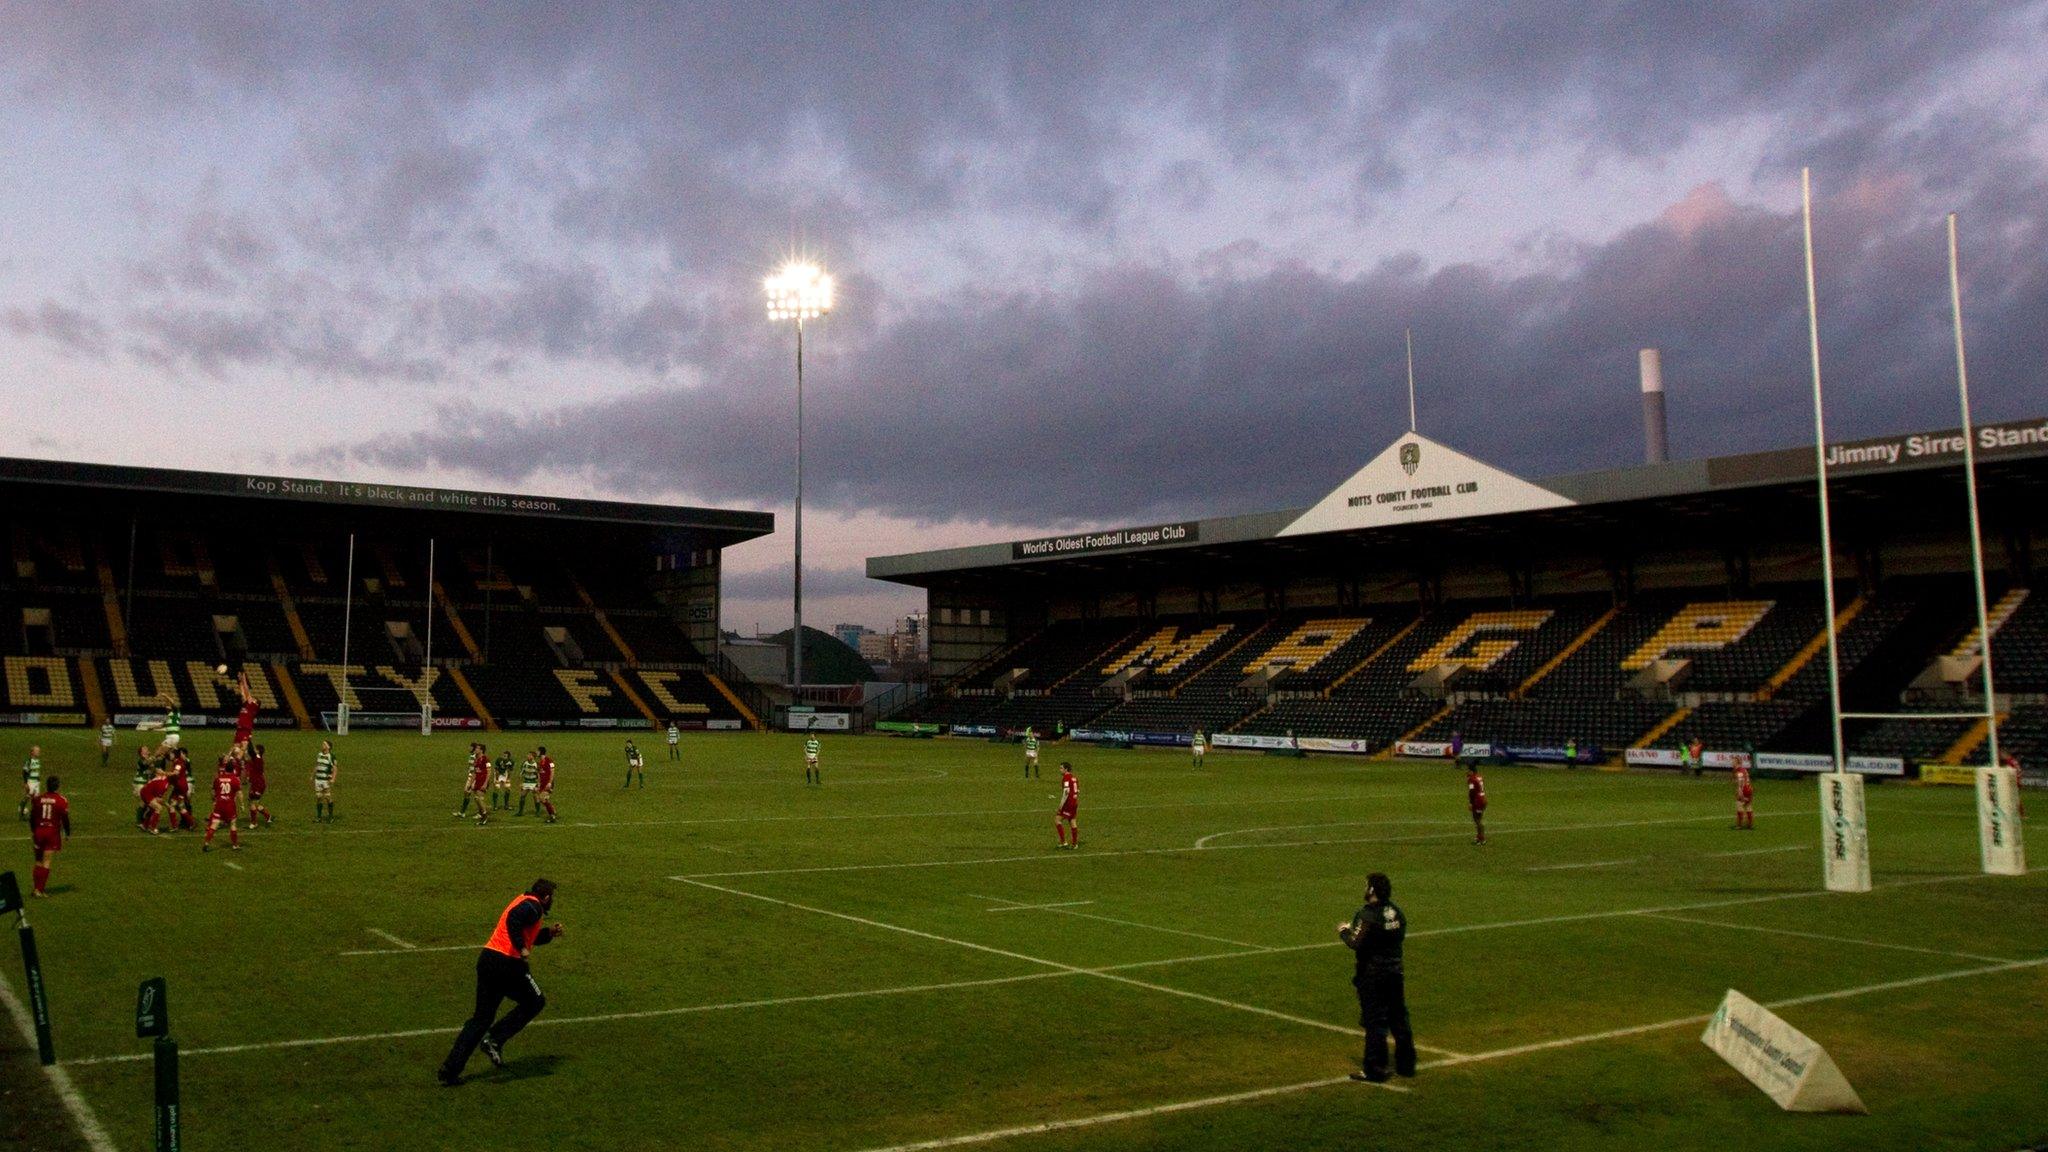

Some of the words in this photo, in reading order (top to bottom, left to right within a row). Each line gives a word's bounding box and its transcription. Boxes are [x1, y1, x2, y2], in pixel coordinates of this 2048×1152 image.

[1826, 443, 1900, 466] Jimmy
[1906, 434, 1968, 456] Sirre
[246, 478, 275, 494] Kop
[281, 480, 328, 496] Stand.
[339, 484, 362, 497] It's
[367, 485, 403, 501] black
[408, 489, 434, 502] and
[440, 491, 478, 506] white
[482, 494, 508, 508] this
[511, 498, 561, 512] season.
[1347, 494, 1372, 507] NOTTS
[1376, 490, 1407, 504] COUNTY
[1411, 484, 1452, 499] FOOTBALL
[1456, 481, 1479, 494] CLUB
[1022, 540, 1053, 554] World's
[1055, 537, 1084, 552] Oldest
[1086, 532, 1122, 548] Football
[1124, 529, 1159, 546] League
[1162, 525, 1186, 540] Club
[688, 607, 712, 619] POST
[552, 668, 711, 714] FC
[1408, 744, 1441, 756] McCann
[1461, 746, 1490, 757] cCann
[220, 782, 231, 794] 20
[42, 804, 52, 819] 11
